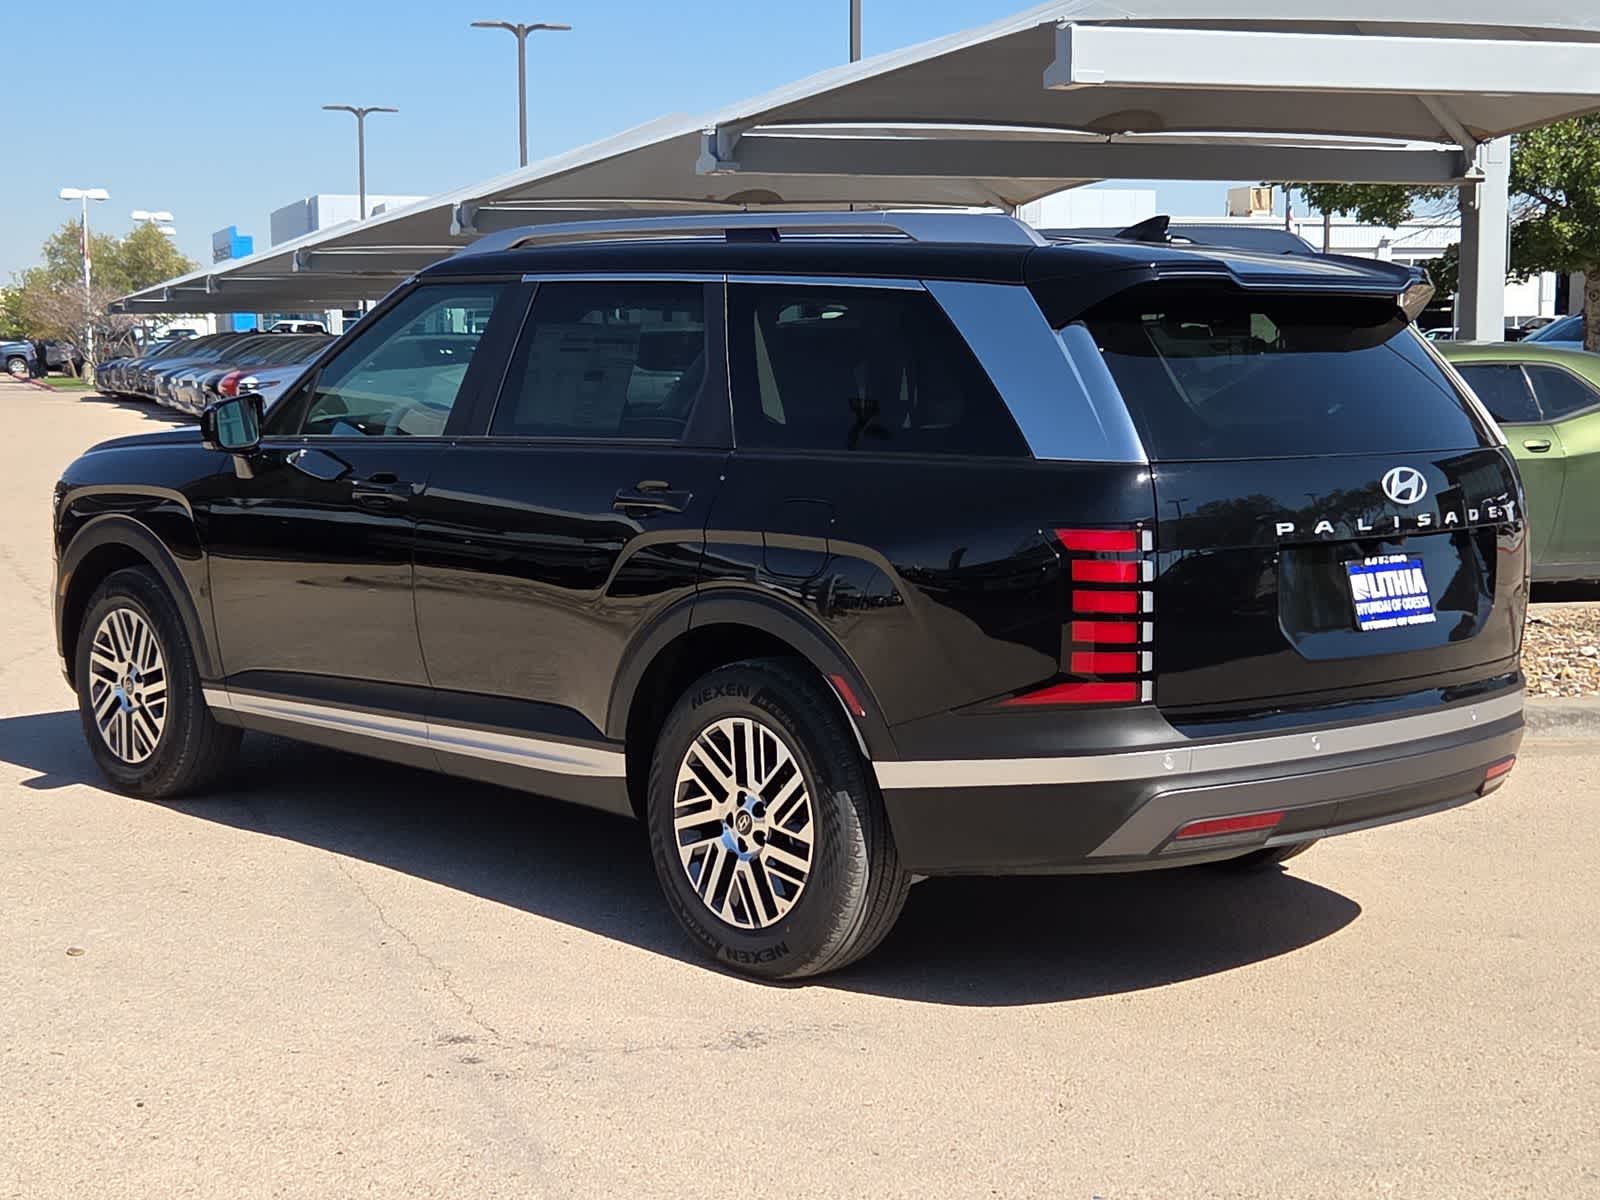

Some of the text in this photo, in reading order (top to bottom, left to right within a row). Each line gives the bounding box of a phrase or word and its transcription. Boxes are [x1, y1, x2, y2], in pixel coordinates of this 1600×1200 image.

[1276, 507, 1498, 536] PALISADE
[1367, 568, 1428, 599] LITHIA
[690, 683, 750, 710] NEXEN
[725, 941, 790, 963] NEXEN
